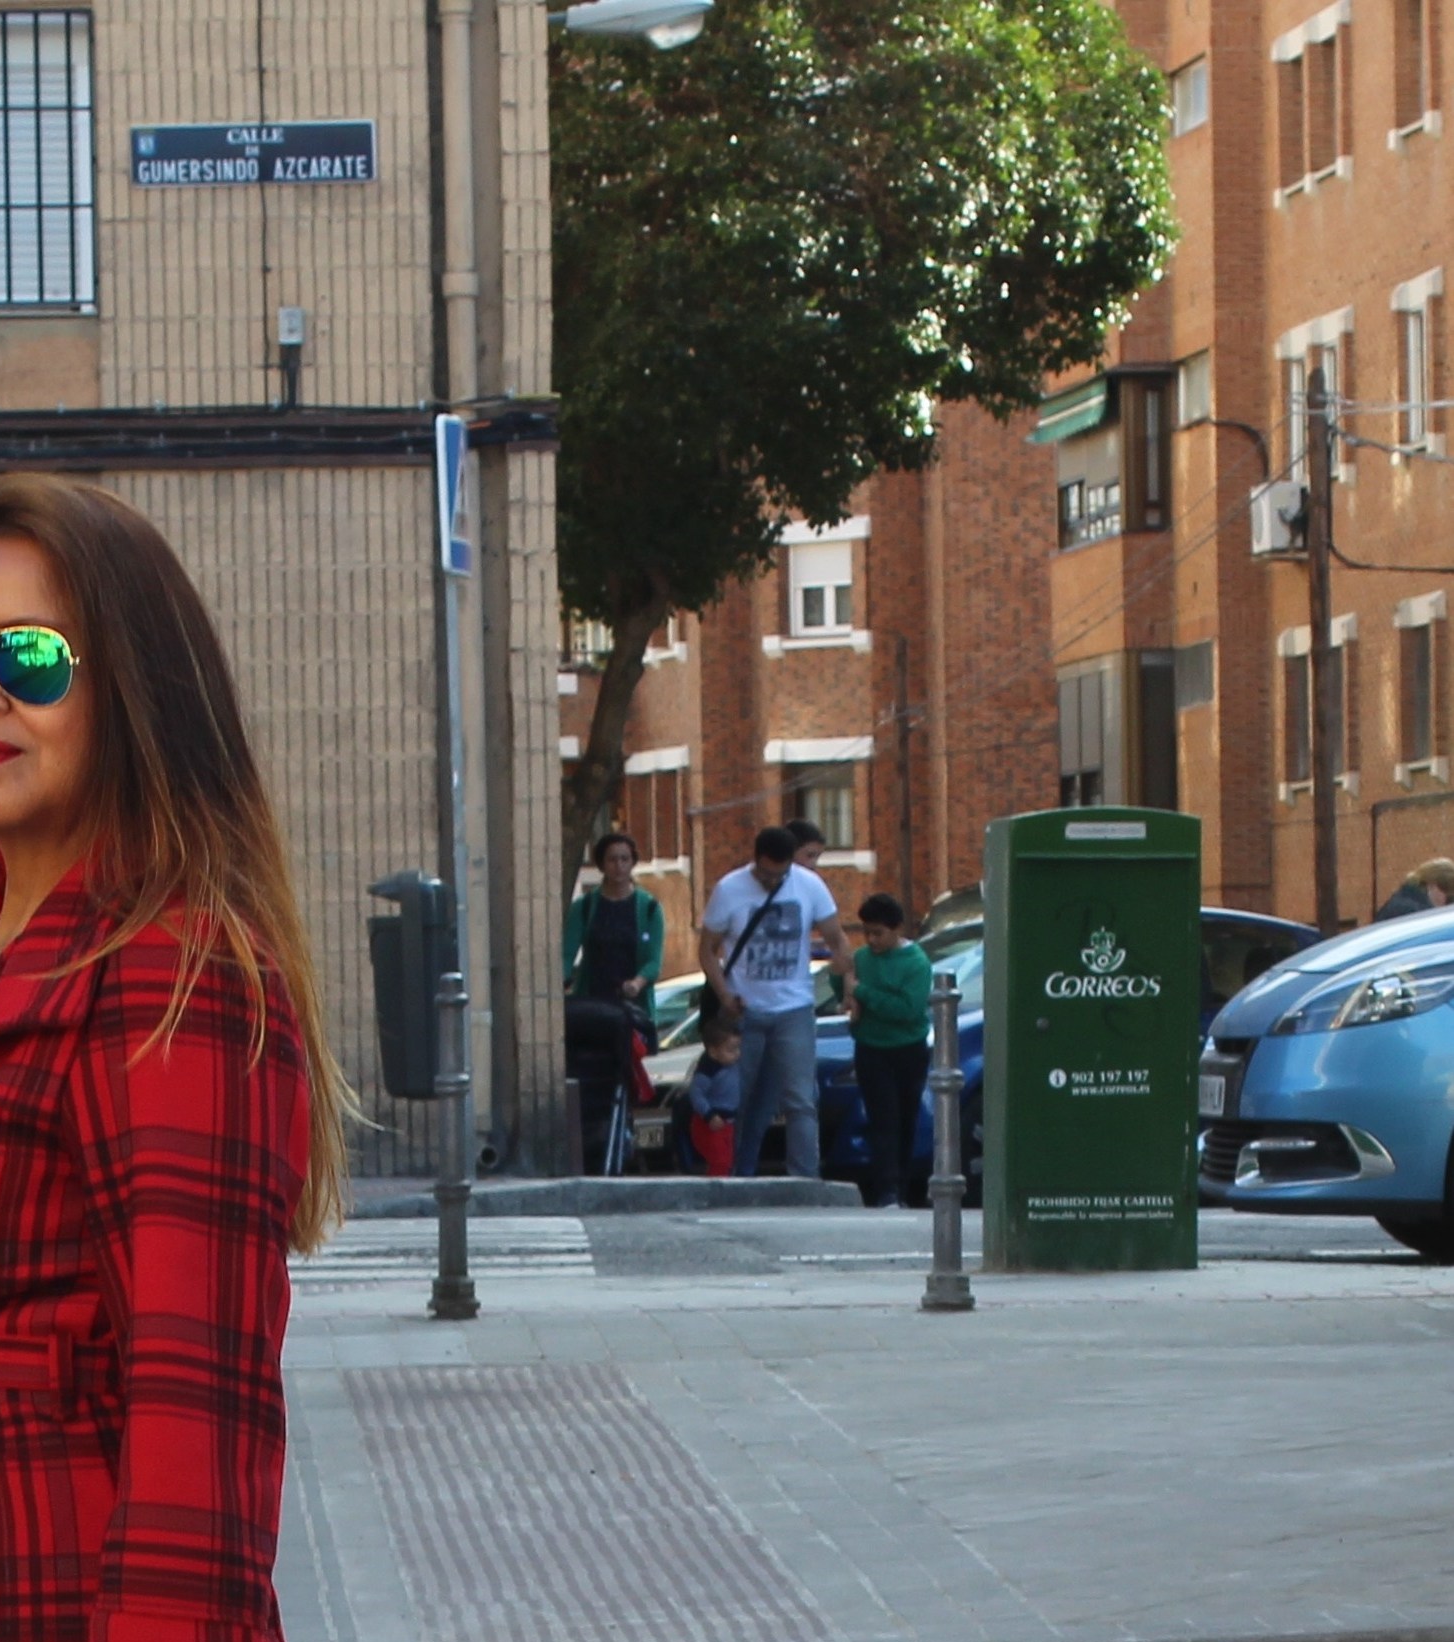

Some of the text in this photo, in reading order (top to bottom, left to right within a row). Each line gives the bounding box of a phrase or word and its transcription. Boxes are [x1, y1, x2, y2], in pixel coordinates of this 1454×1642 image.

[226, 127, 284, 145] CALLE
[138, 155, 368, 183] GUMERSINDO AZCARATE
[1071, 1069, 1149, 1083] 902 197 197
[1028, 1195, 1174, 1208] PROHIBIDO FIJAR CARTELES
